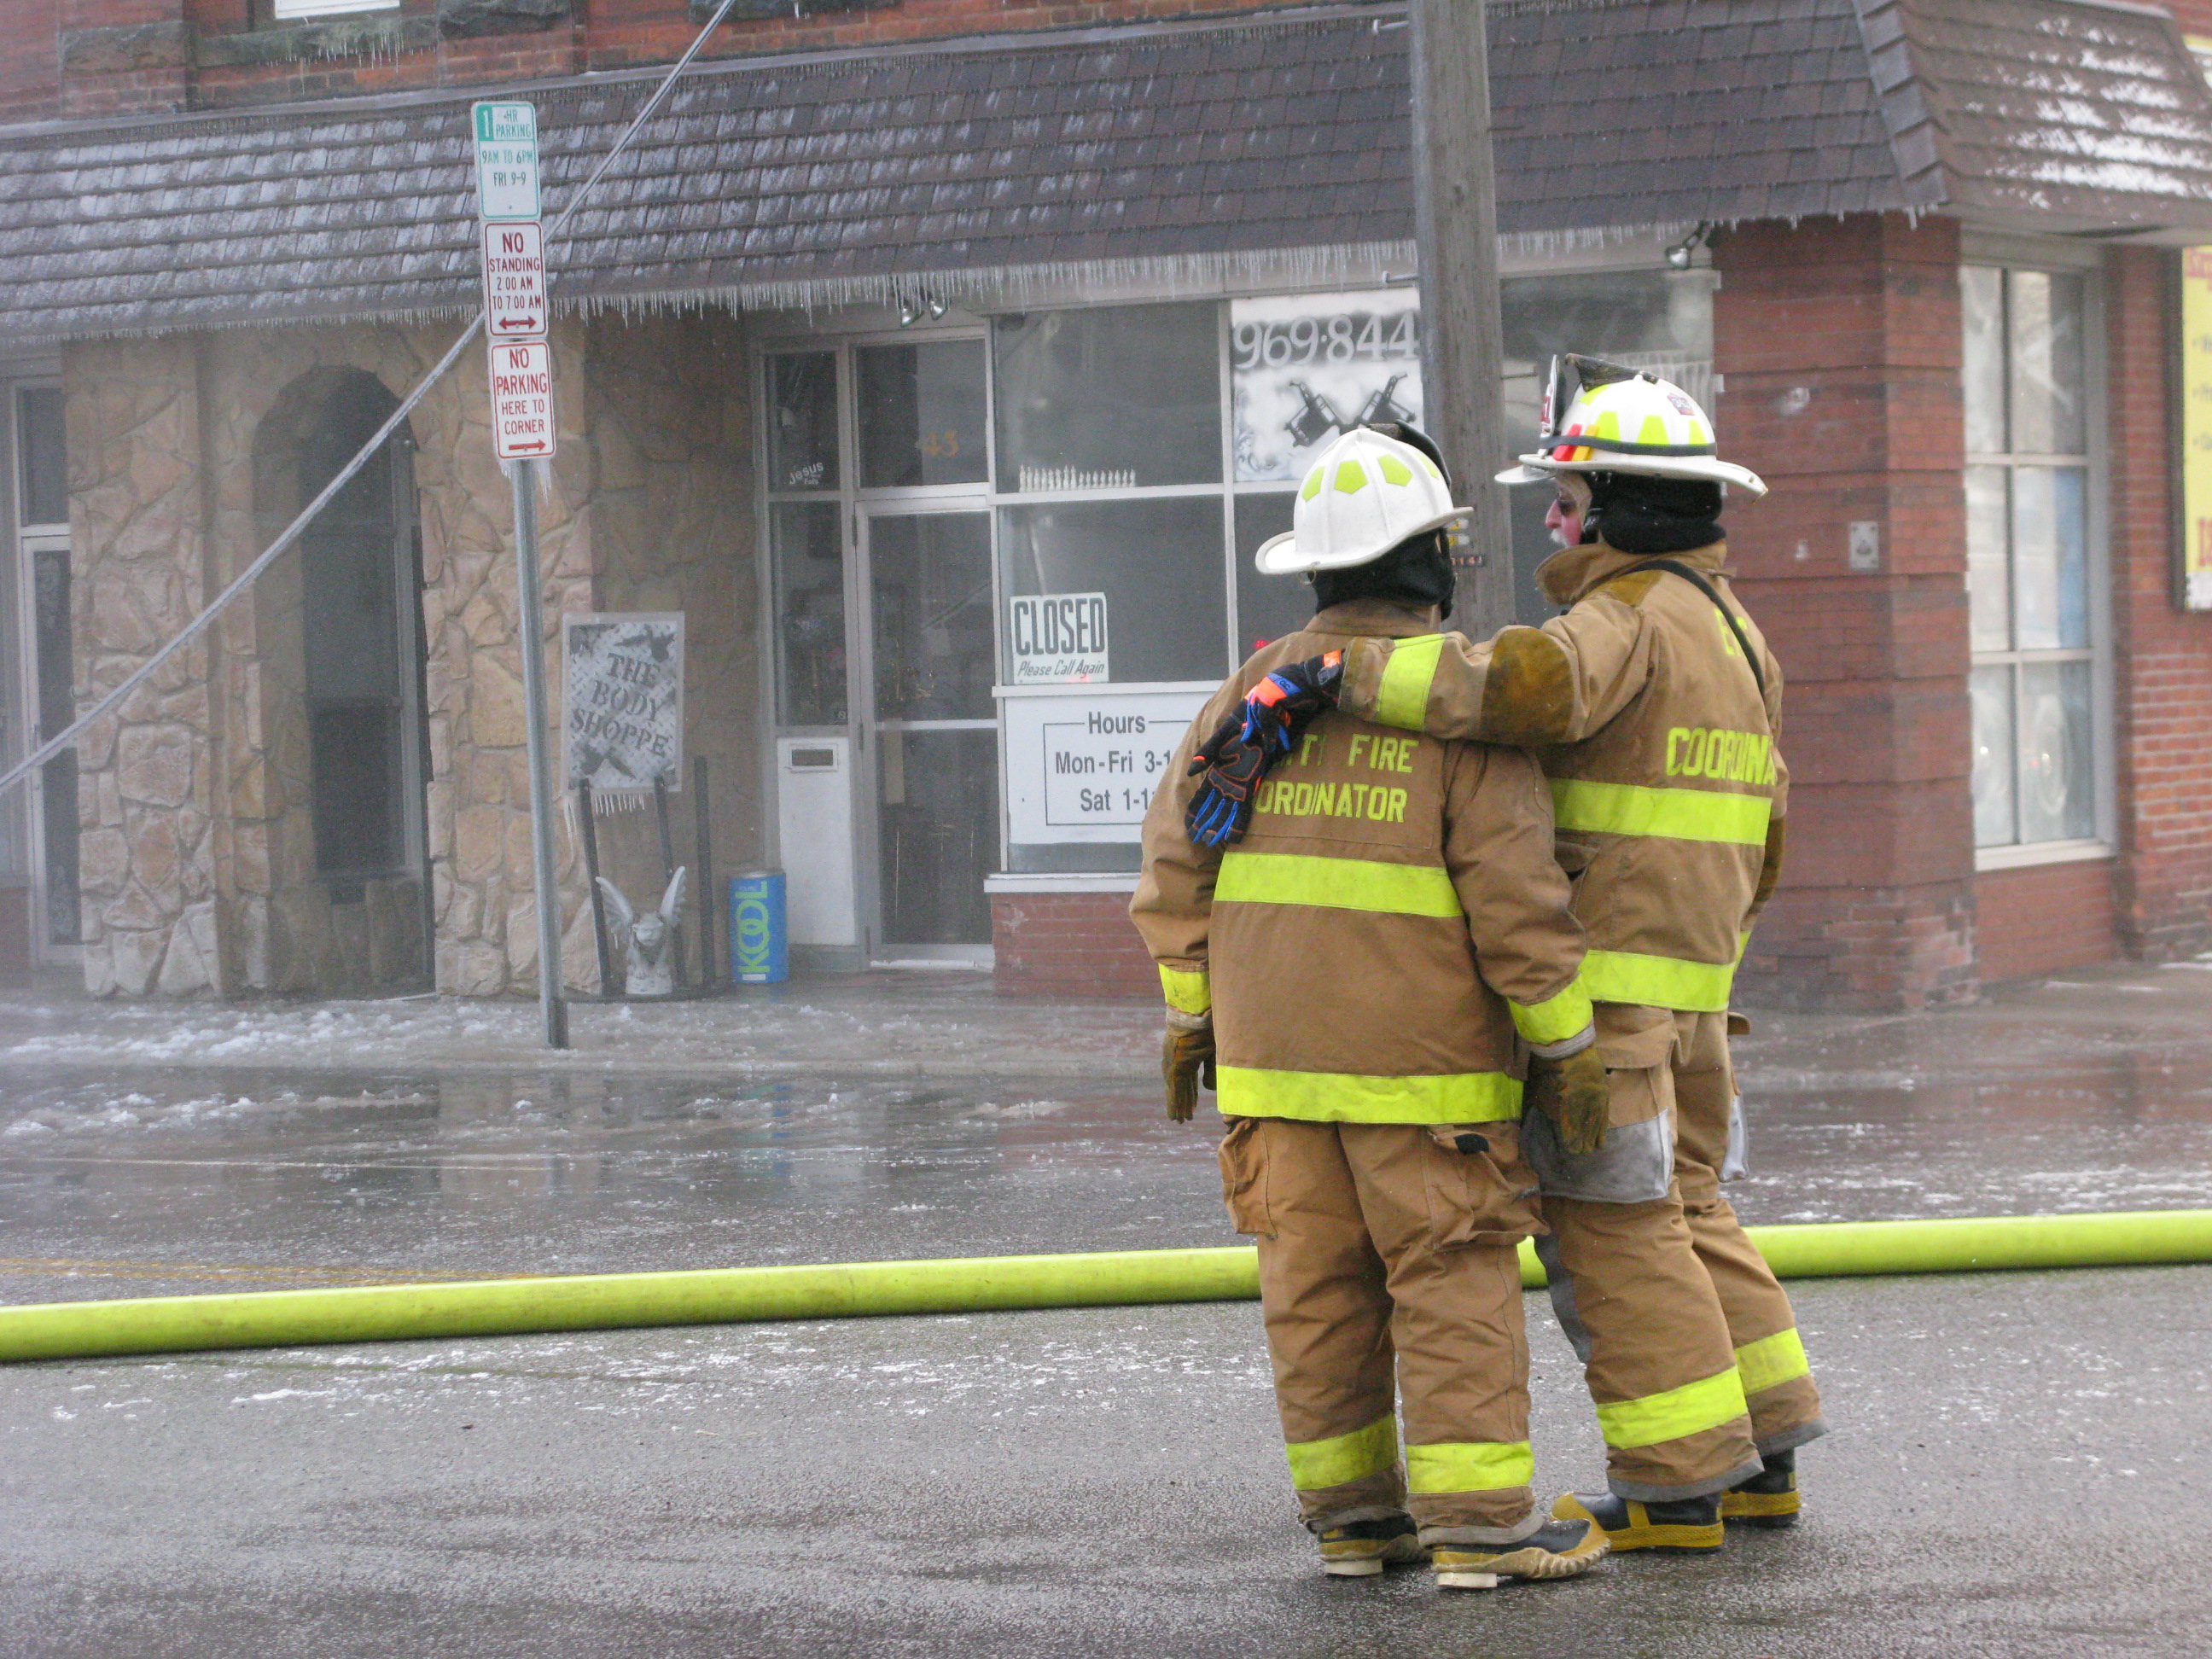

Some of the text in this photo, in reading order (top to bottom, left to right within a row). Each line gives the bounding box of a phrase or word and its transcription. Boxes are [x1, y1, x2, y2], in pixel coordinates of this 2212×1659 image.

[483, 109, 490, 138] 1
[496, 124, 532, 138] PARKING
[482, 149, 533, 164] 9AM TO 6PM
[493, 172, 527, 186] FRI 9-9
[502, 231, 524, 253] NO
[489, 257, 540, 272] STANDING
[520, 276, 533, 291] AM
[492, 295, 503, 310] TO
[528, 293, 542, 309] AM
[509, 347, 530, 370] NO
[496, 372, 547, 397] PARKING
[501, 397, 544, 416] HERE TO
[504, 419, 544, 435] CORNER
[1014, 597, 1106, 656] CLOSED
[607, 652, 661, 689] THE
[1018, 659, 1105, 679] Please Call Again
[591, 680, 665, 721] BODY
[570, 708, 668, 759] SHOPPE
[1088, 712, 1146, 734] Hours
[1348, 733, 1419, 773] FIRE
[1666, 727, 1778, 786] COORDINA
[1080, 788, 1155, 812] Sat 1-1
[1254, 780, 1408, 823] ORDINATOR
[735, 880, 771, 973] KOOL
